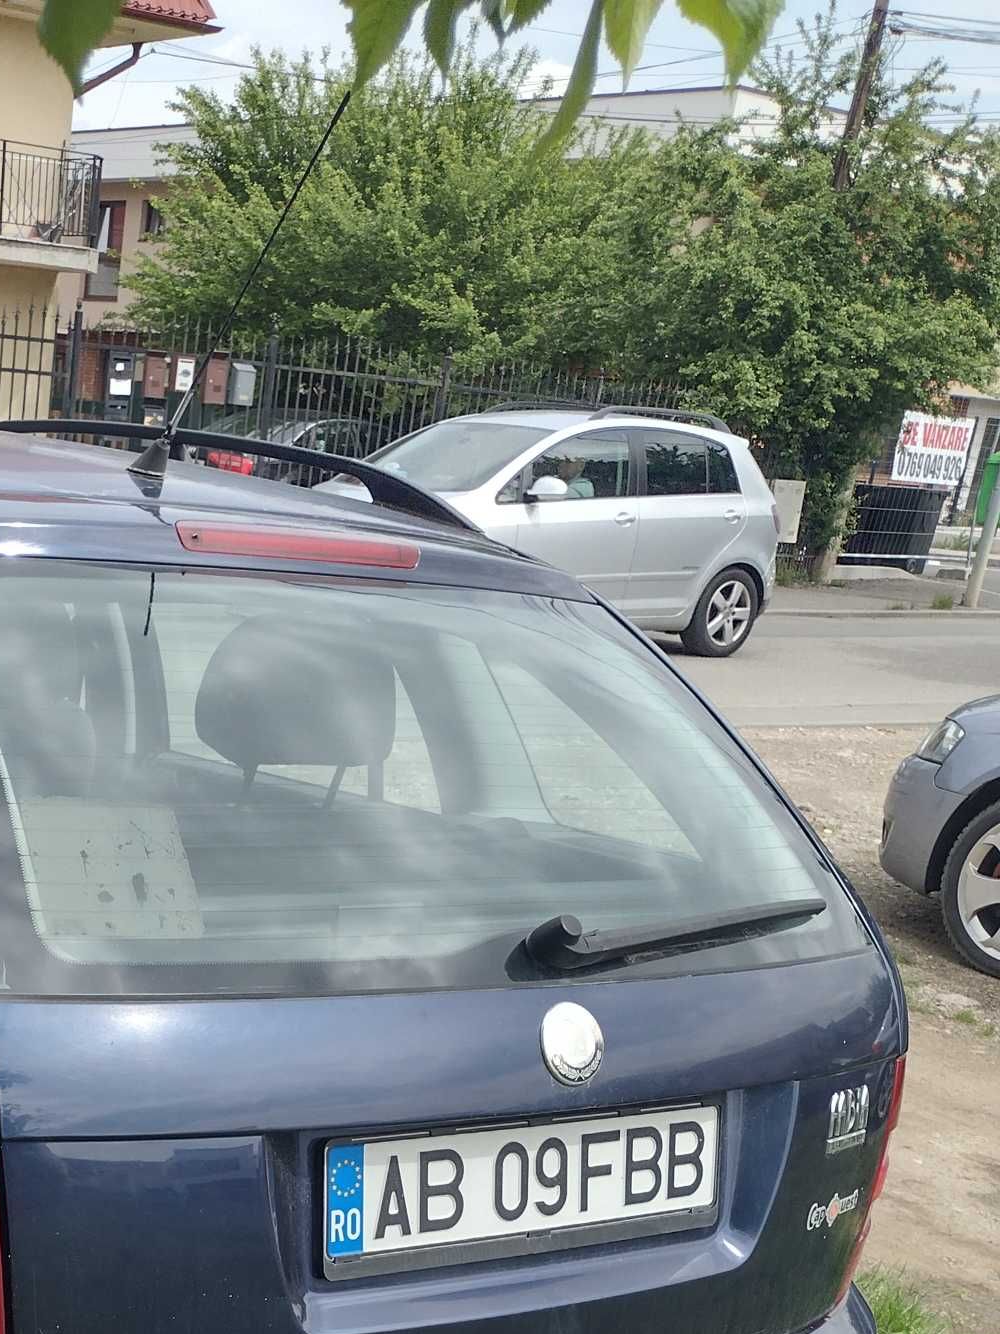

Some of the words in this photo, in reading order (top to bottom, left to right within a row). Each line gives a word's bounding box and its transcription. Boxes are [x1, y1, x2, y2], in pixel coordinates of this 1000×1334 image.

[922, 422, 970, 452] VANZARE
[897, 451, 923, 477] 0769
[922, 453, 944, 479] 049
[943, 455, 963, 480] 926
[374, 1148, 465, 1240] AB
[494, 1120, 705, 1222] 09FBB
[330, 1207, 361, 1243] RO
